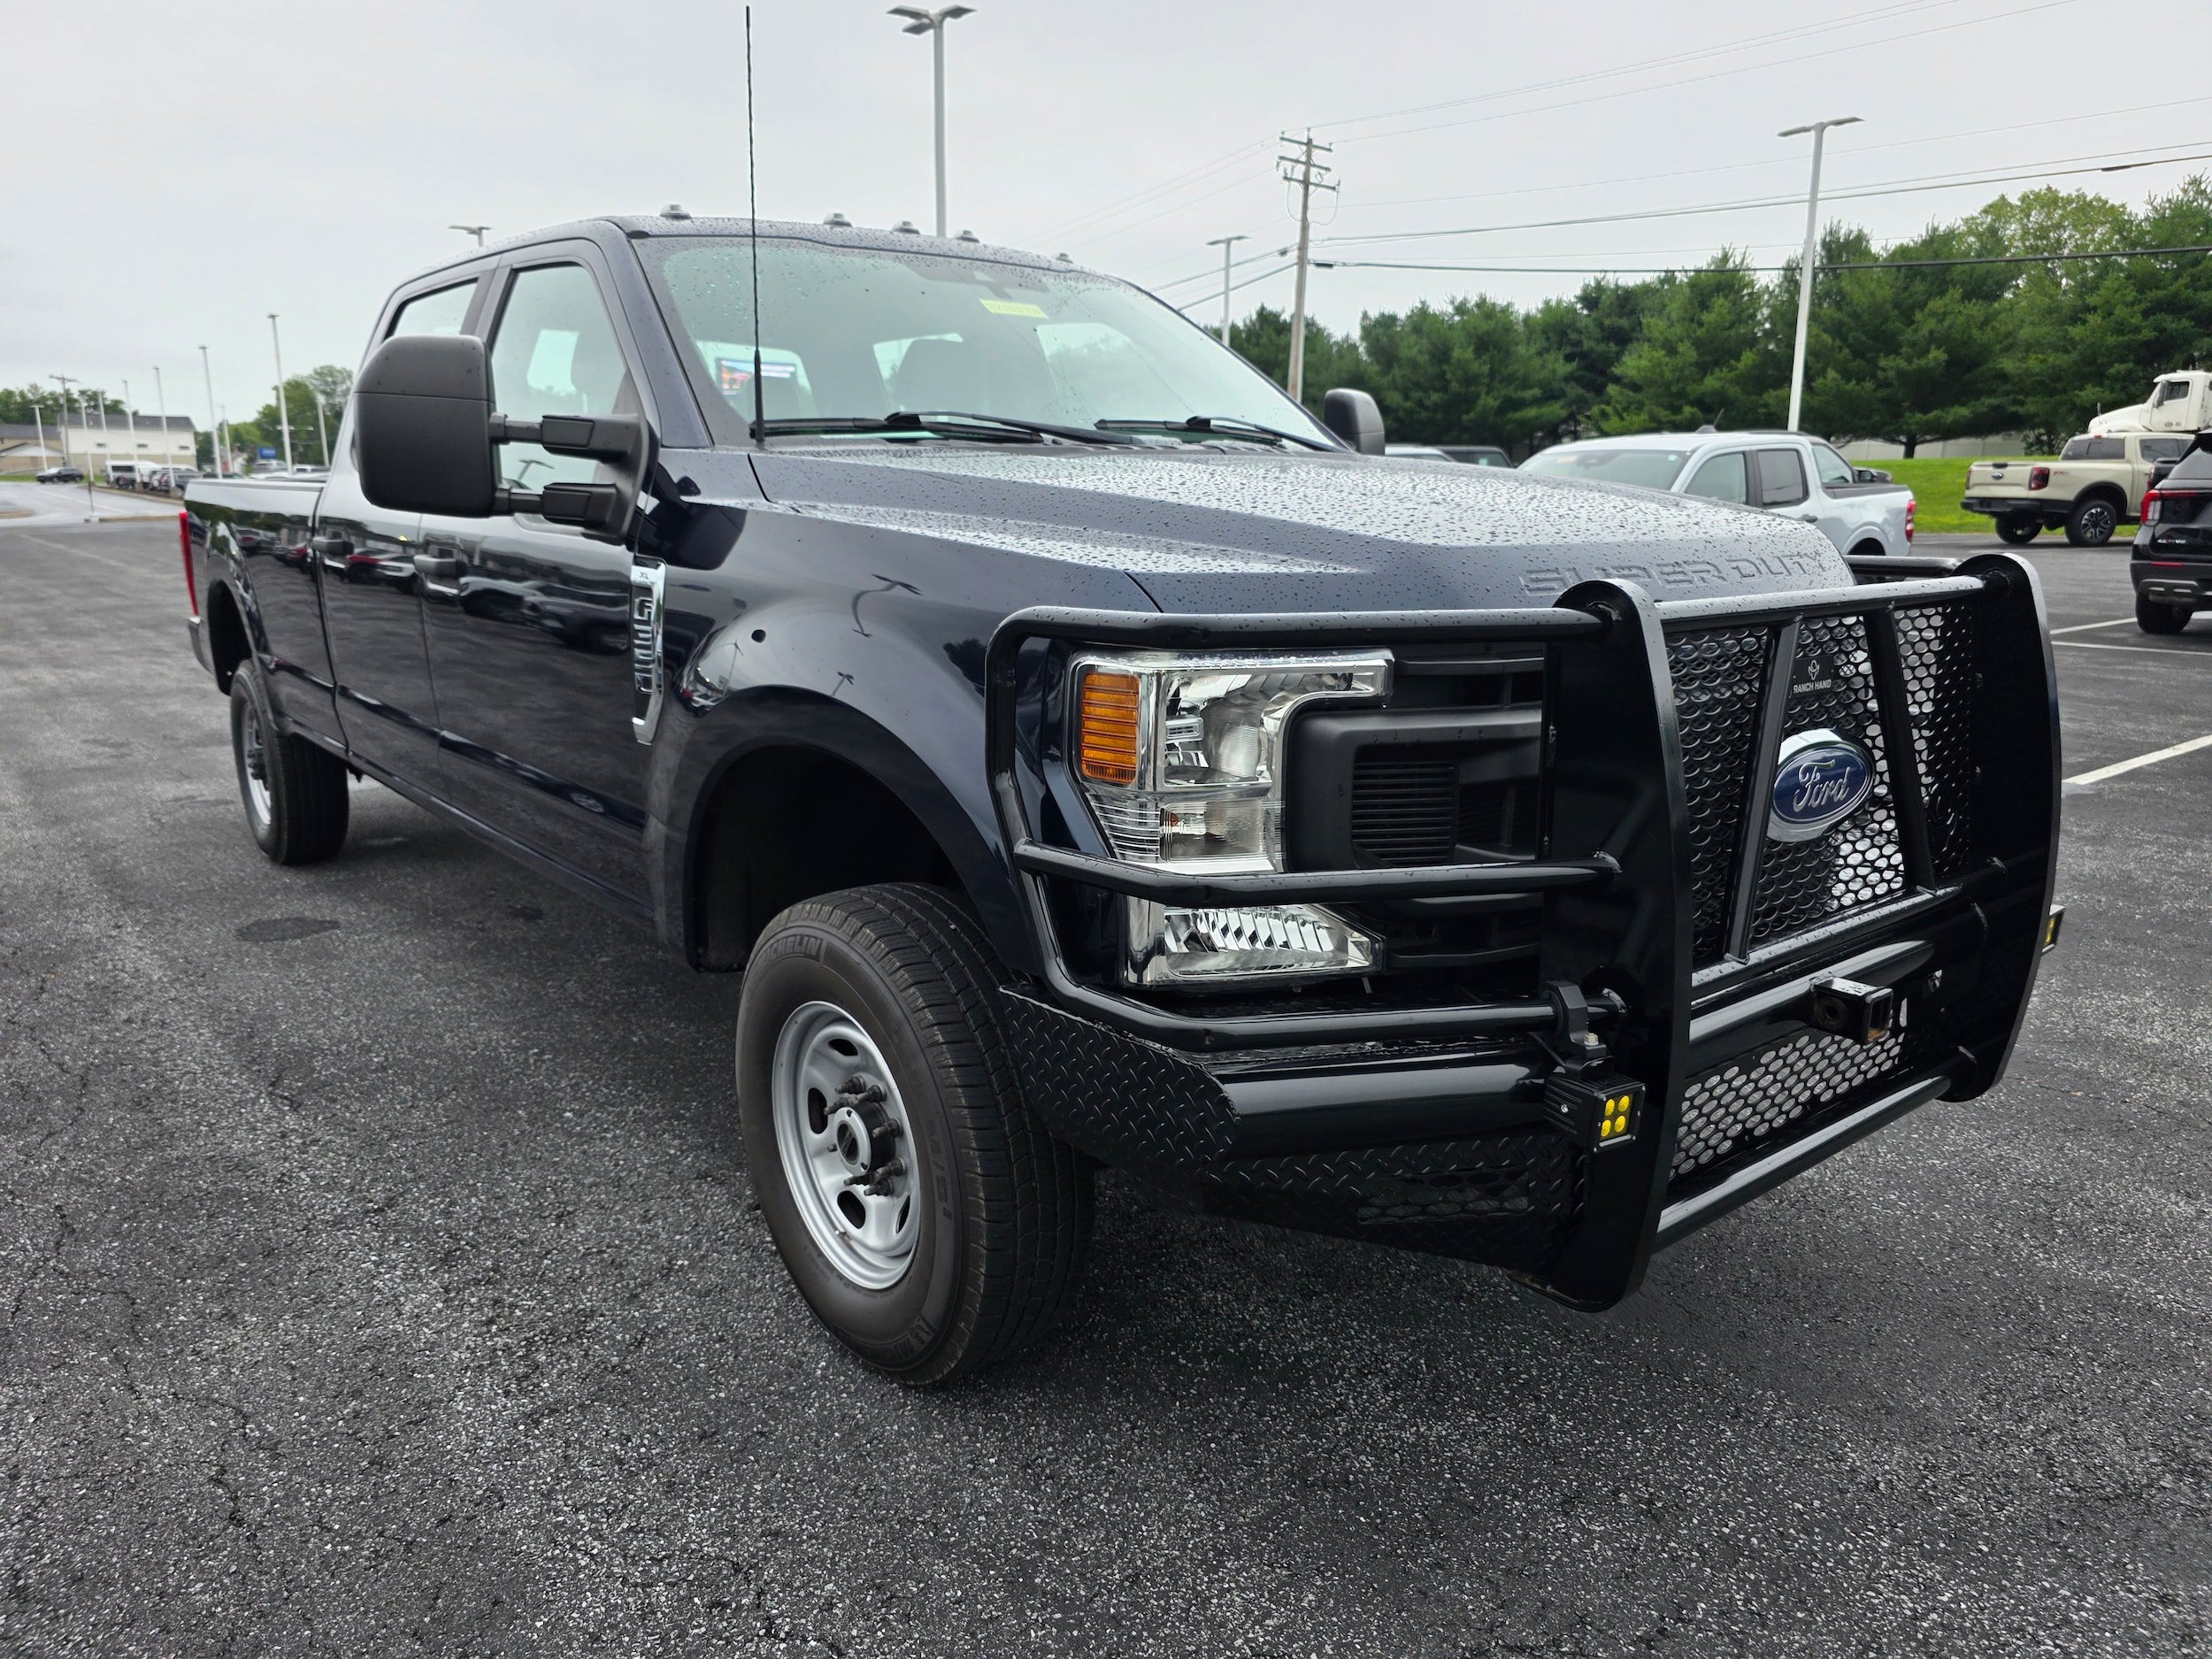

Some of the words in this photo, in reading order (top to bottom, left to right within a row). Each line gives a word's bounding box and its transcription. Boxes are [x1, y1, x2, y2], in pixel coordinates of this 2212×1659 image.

[639, 572, 649, 580] XL
[1725, 552, 1827, 580] DUTY
[1793, 681, 1814, 694] RANCH
[1814, 679, 1832, 690] HAND
[1793, 759, 1850, 812] Ford
